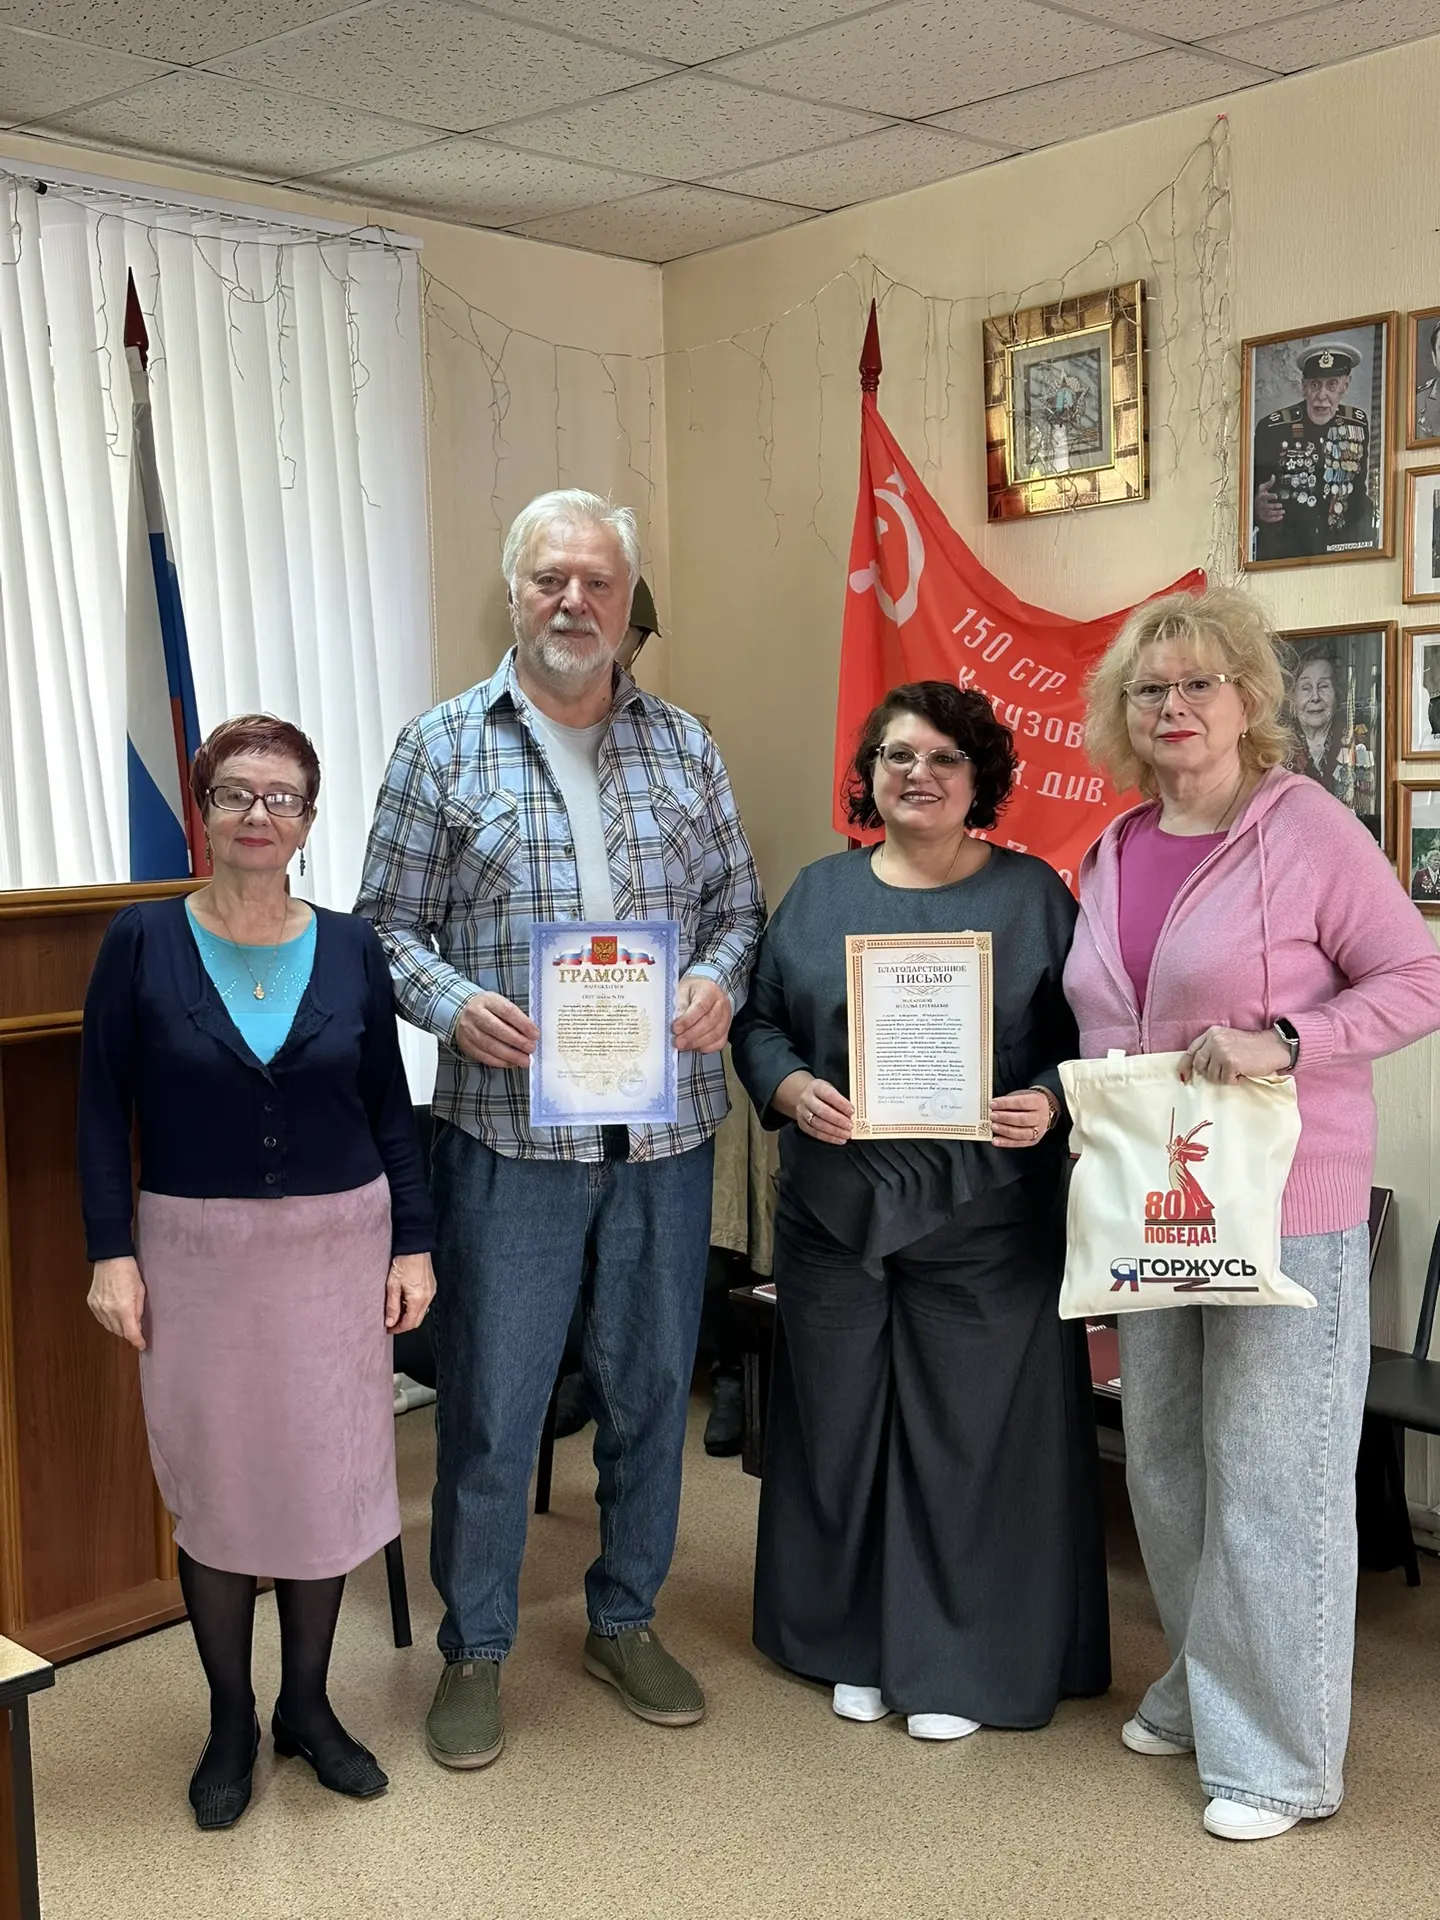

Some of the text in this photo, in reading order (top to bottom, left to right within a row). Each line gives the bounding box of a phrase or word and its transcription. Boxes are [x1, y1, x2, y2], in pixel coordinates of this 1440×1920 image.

[952, 608, 1067, 695] 150 СТР.
[1036, 771, 1108, 807] ДИВ.
[559, 968, 650, 983] ГРАМОТА
[877, 965, 967, 974] БЛАГОДАРСТВЕННОЕ
[895, 973, 953, 984] ПИСЬМО
[1145, 1190, 1182, 1220] 80
[1144, 1226, 1217, 1247] ПОБЕДА!
